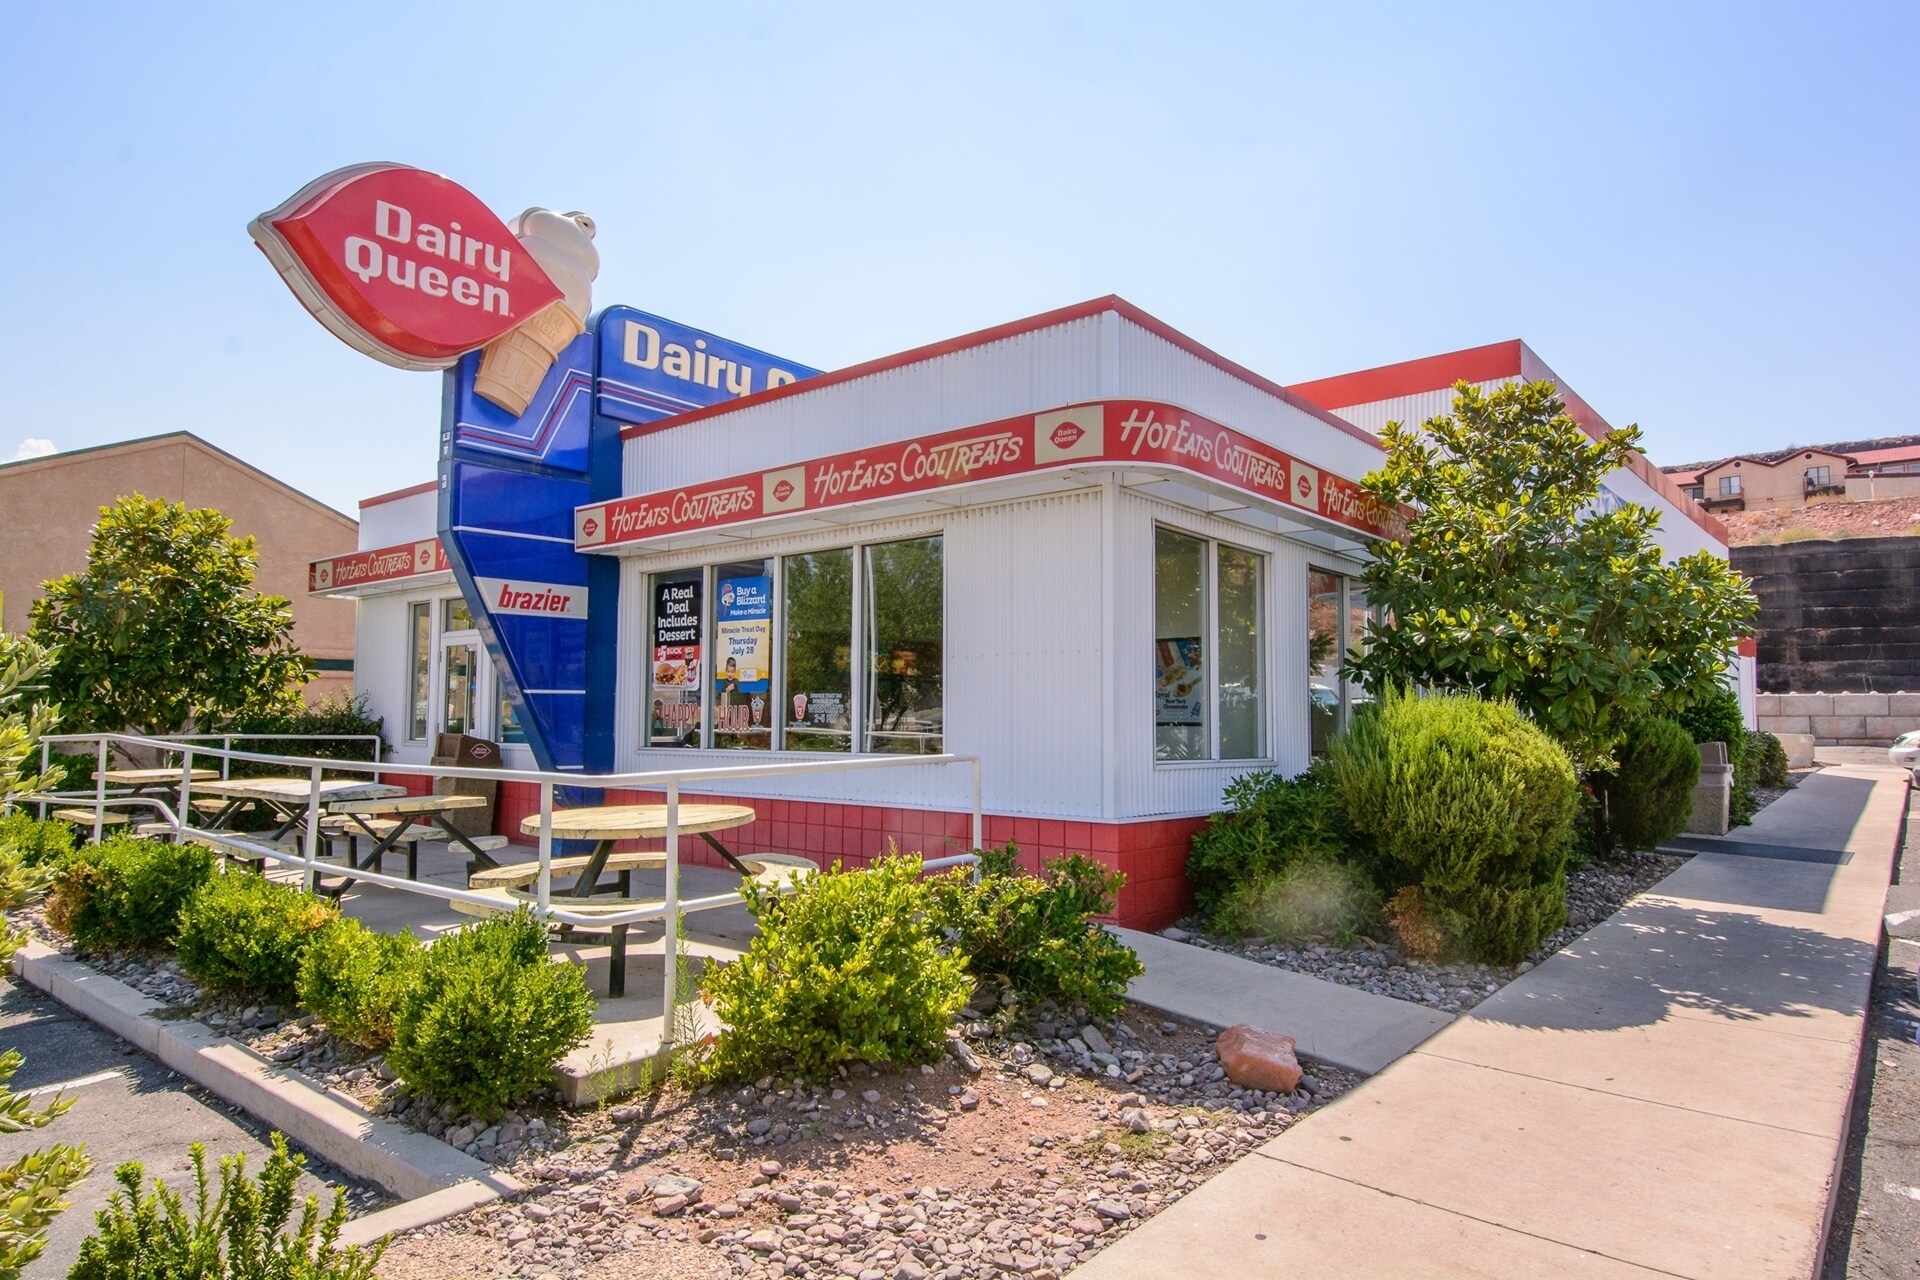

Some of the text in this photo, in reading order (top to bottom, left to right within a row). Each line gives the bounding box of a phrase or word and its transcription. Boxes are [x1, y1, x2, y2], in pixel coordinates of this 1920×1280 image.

[375, 199, 511, 283] Dairy
[344, 235, 509, 317] Queen
[623, 319, 751, 397] Dairy
[1053, 434, 1078, 445] Queen
[1057, 428, 1077, 437] Dairy
[497, 583, 571, 612] brazier
[662, 585, 694, 601] A Real
[736, 586, 757, 597] Buy a
[666, 599, 690, 614] Deal
[736, 594, 766, 606] Blizzard
[747, 607, 767, 615] Miracle
[657, 615, 698, 629] Includes
[658, 628, 696, 642] Dessert
[721, 625, 766, 634] Miracle Treat Day
[728, 637, 758, 646] Thursday
[731, 646, 755, 656] July 28
[663, 702, 751, 731] HAPPY HOUR
